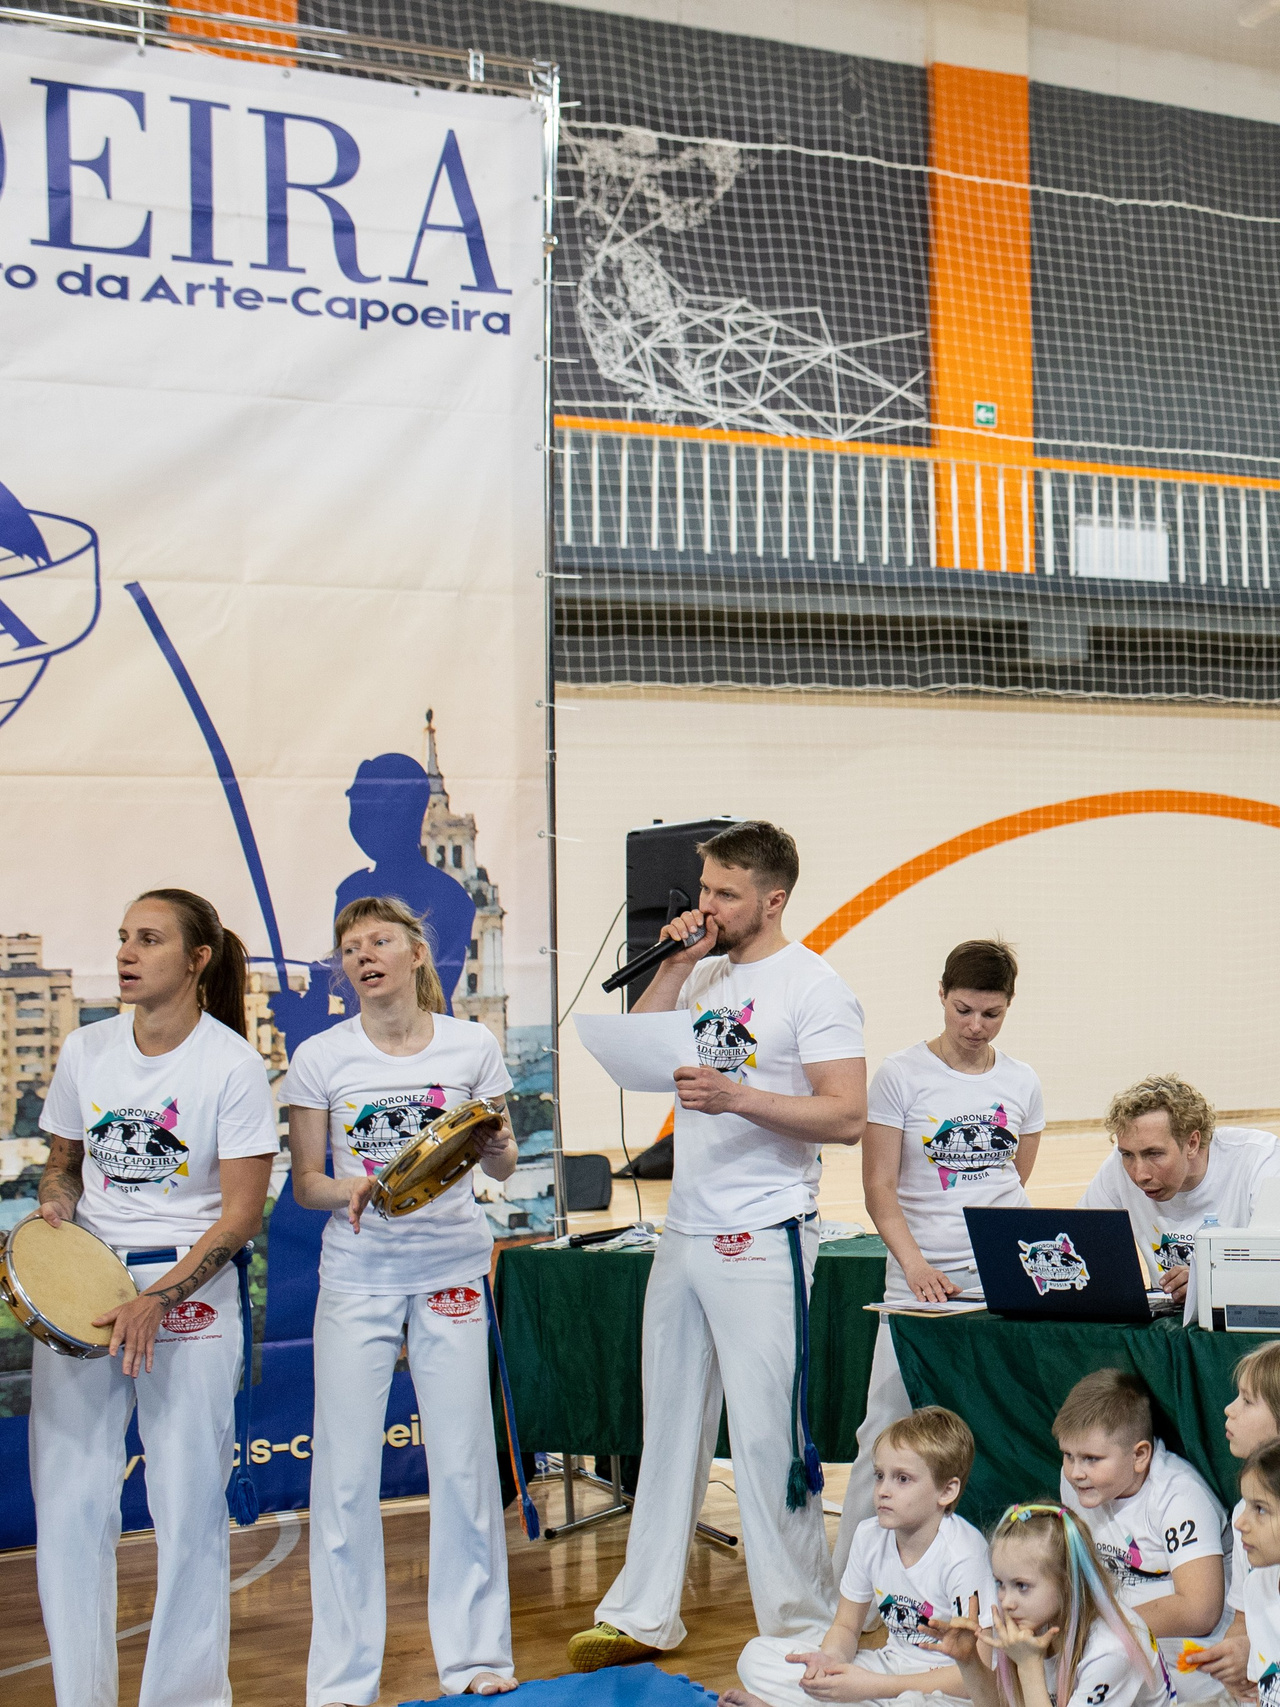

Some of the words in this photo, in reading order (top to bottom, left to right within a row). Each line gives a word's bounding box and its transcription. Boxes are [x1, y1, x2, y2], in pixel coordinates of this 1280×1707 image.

[0, 78, 512, 295] EIRA
[57, 263, 129, 300] da
[141, 274, 511, 336] Arte-Capoeira
[371, 1094, 434, 1109] VORONEZH
[113, 1108, 167, 1123] VORONEZH
[950, 1114, 999, 1124] VORONEZH
[961, 1171, 990, 1181] RUSSIA
[1165, 1519, 1198, 1554] 82
